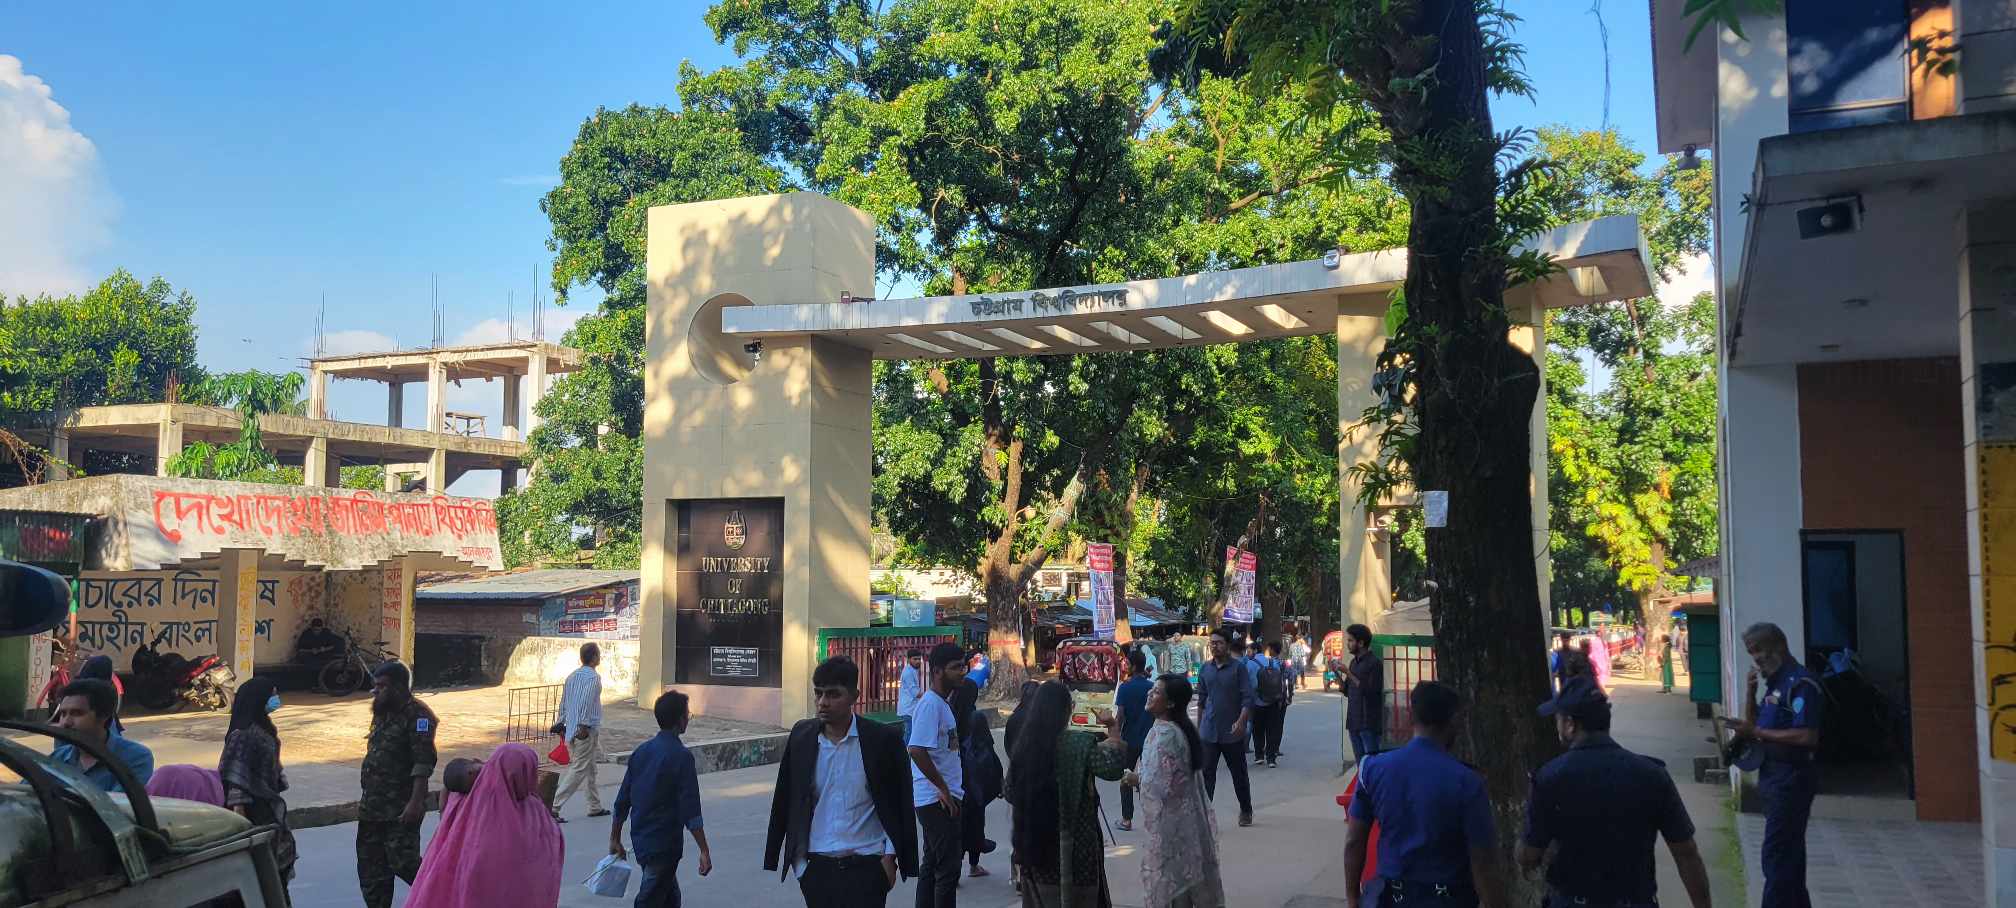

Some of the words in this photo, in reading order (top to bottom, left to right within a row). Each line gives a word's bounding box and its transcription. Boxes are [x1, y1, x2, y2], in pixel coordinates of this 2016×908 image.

[967, 296, 1025, 315] চট্টগ্রাম
[701, 556, 770, 573] UNIVERSITY
[727, 578, 744, 594] OF
[699, 598, 770, 615] CHITTAGONG
